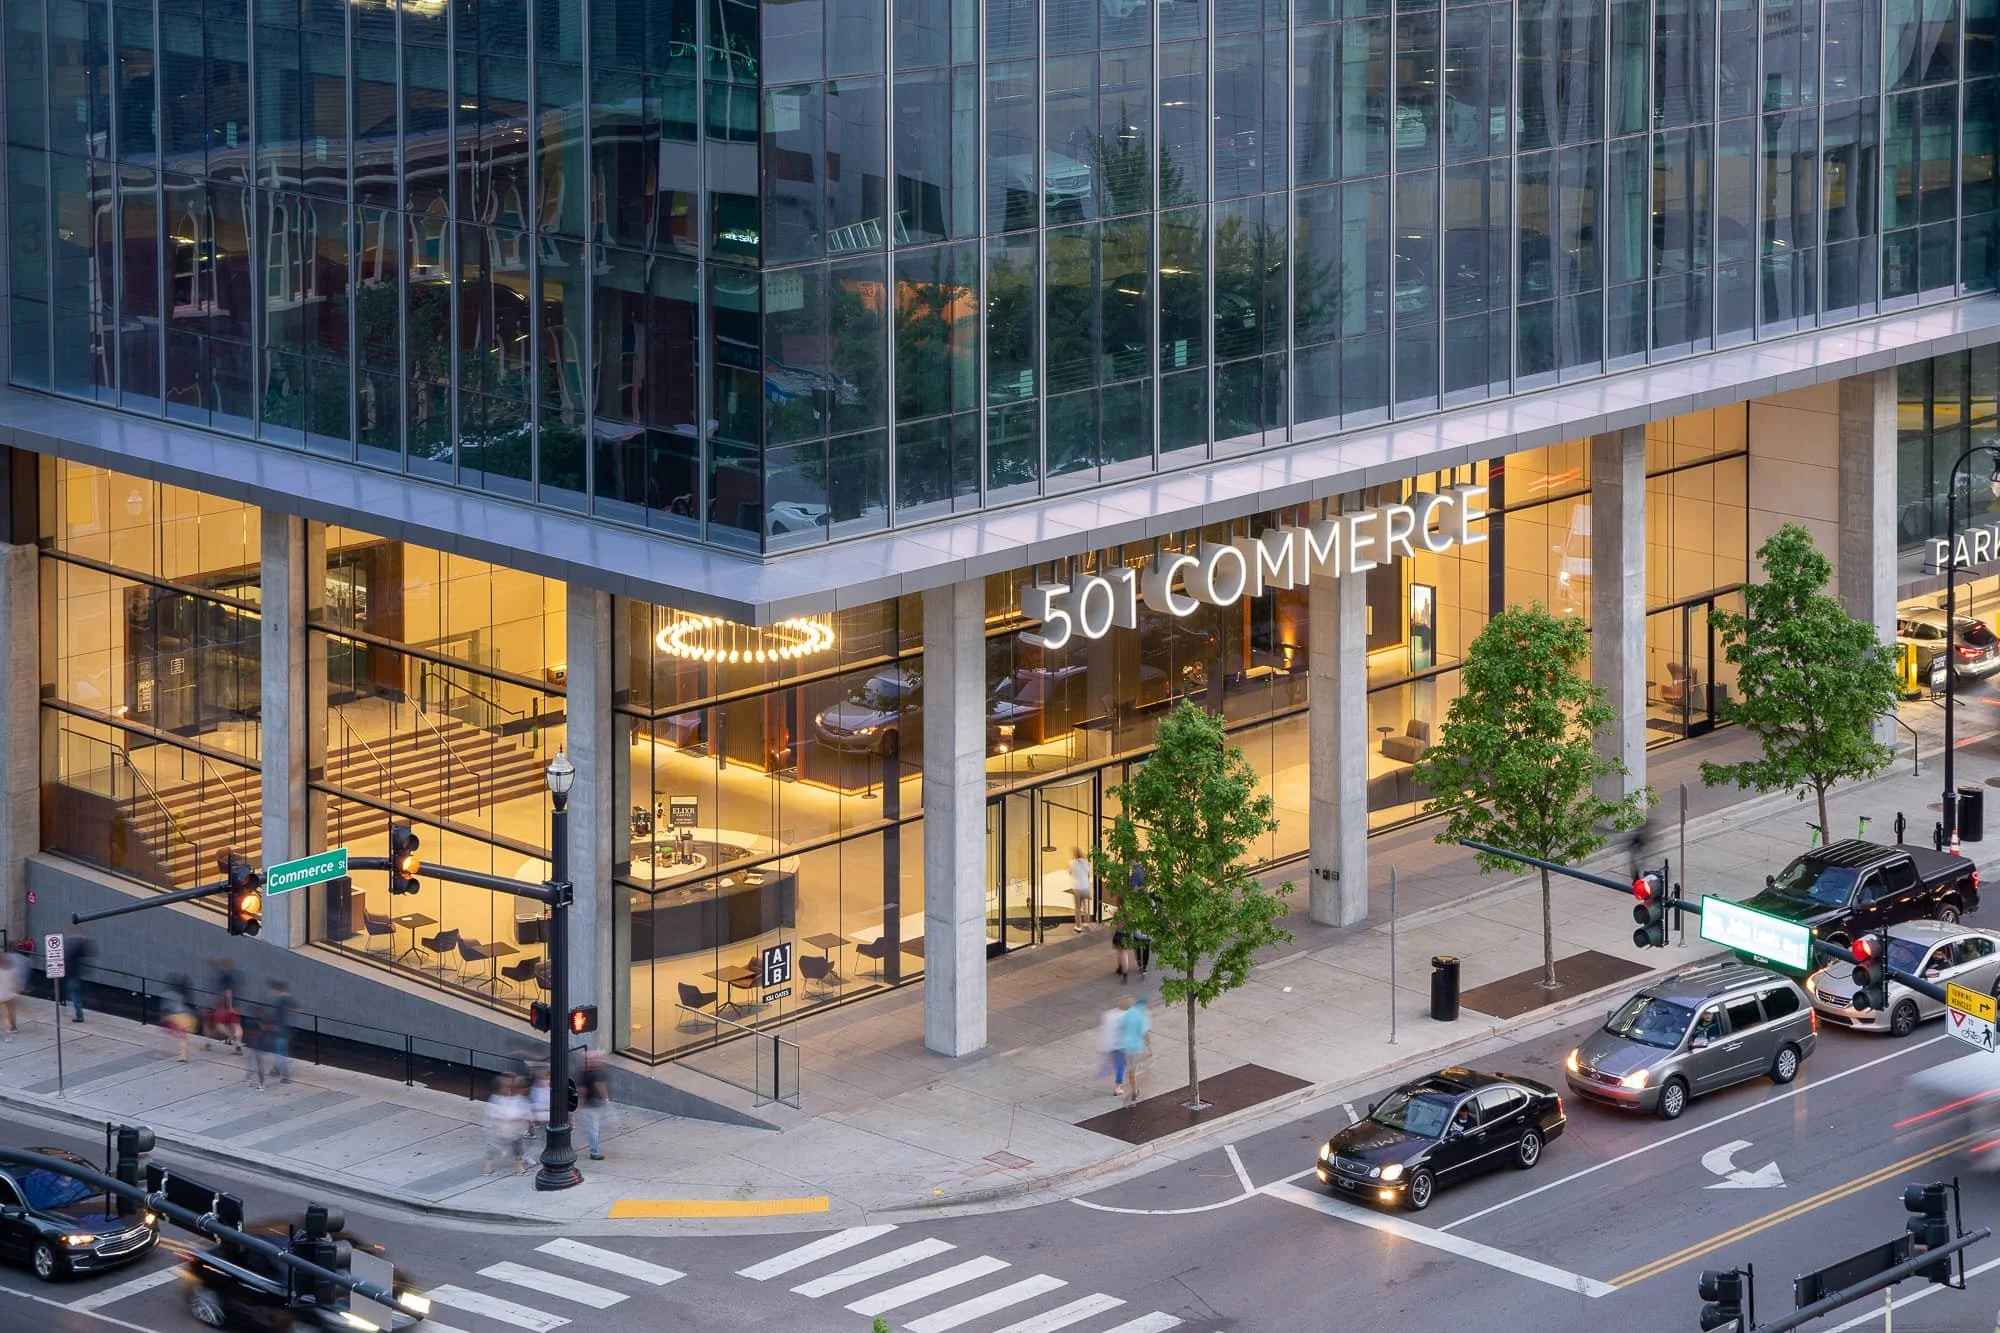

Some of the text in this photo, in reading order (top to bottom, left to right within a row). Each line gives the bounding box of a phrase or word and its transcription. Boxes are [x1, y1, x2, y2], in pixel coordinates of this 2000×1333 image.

[1043, 486, 1488, 650] 501 COMMERCE
[269, 860, 346, 887] Commerce St
[773, 948, 782, 963] A
[773, 968, 782, 984] B
